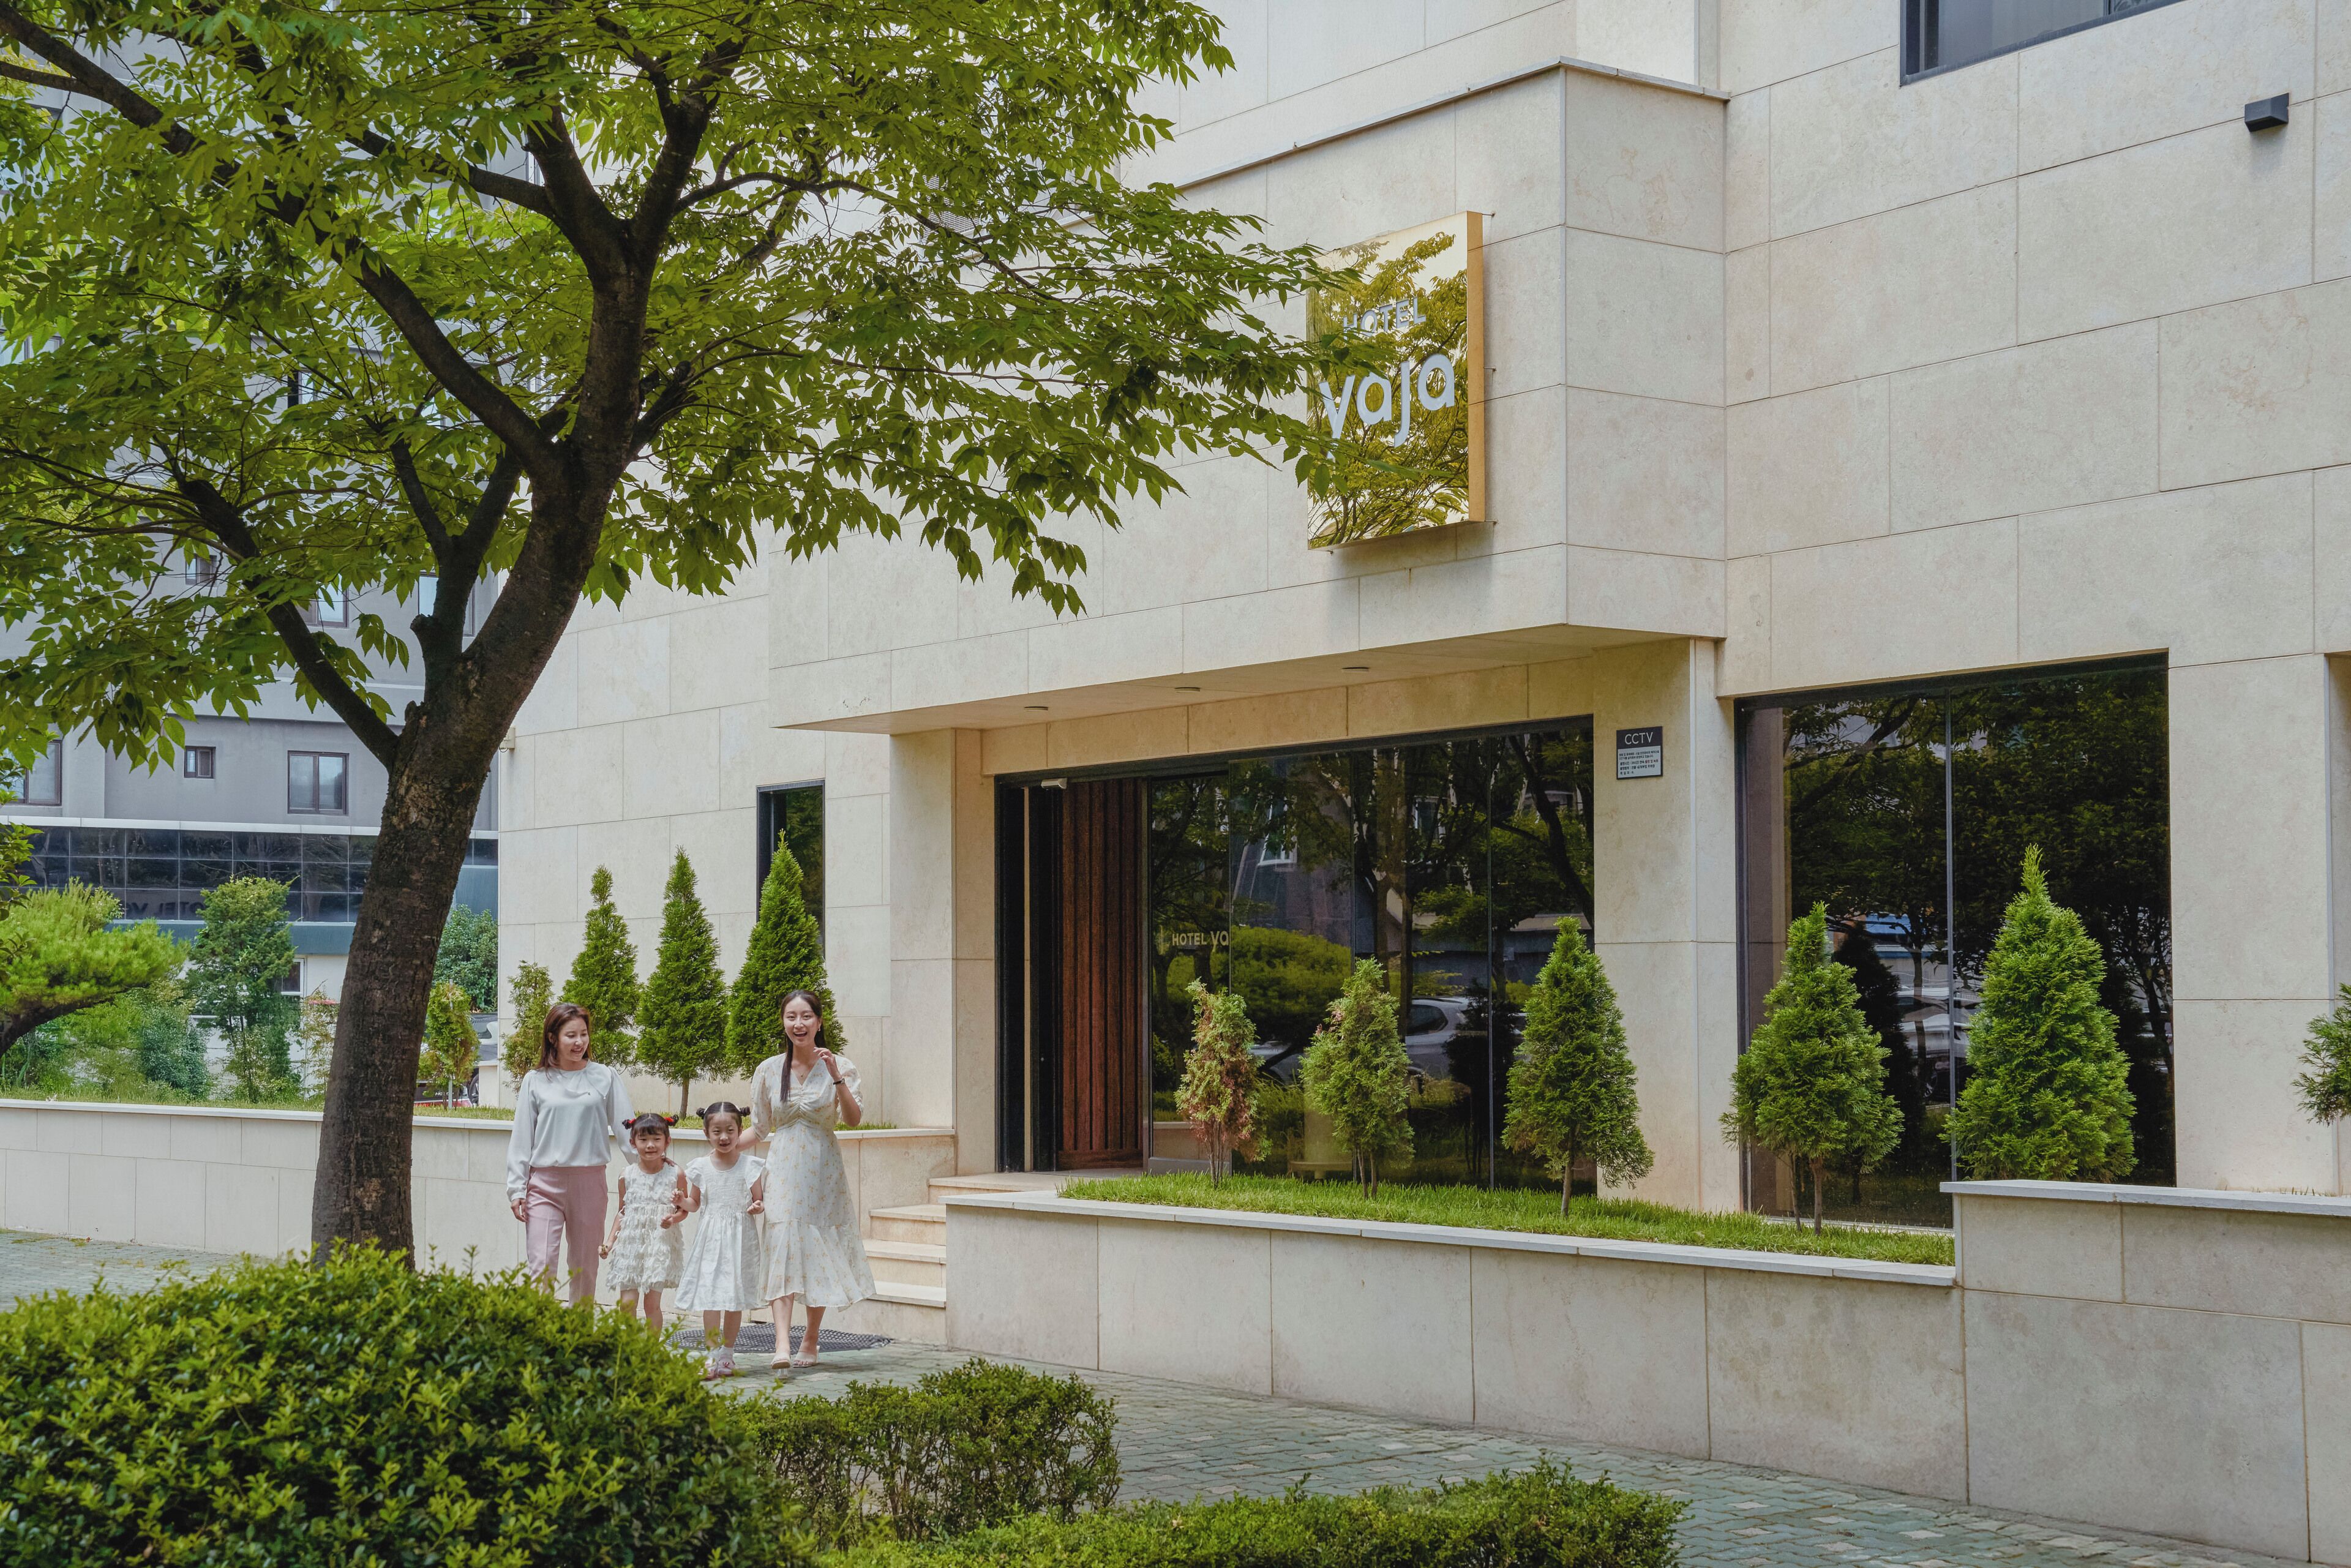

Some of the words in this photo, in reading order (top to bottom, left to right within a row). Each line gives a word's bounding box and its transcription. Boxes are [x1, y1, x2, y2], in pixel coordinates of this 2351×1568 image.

[1343, 296, 1426, 340] HOTEL
[1625, 732, 1653, 745] CCTV
[1172, 932, 1207, 945] HOTEL
